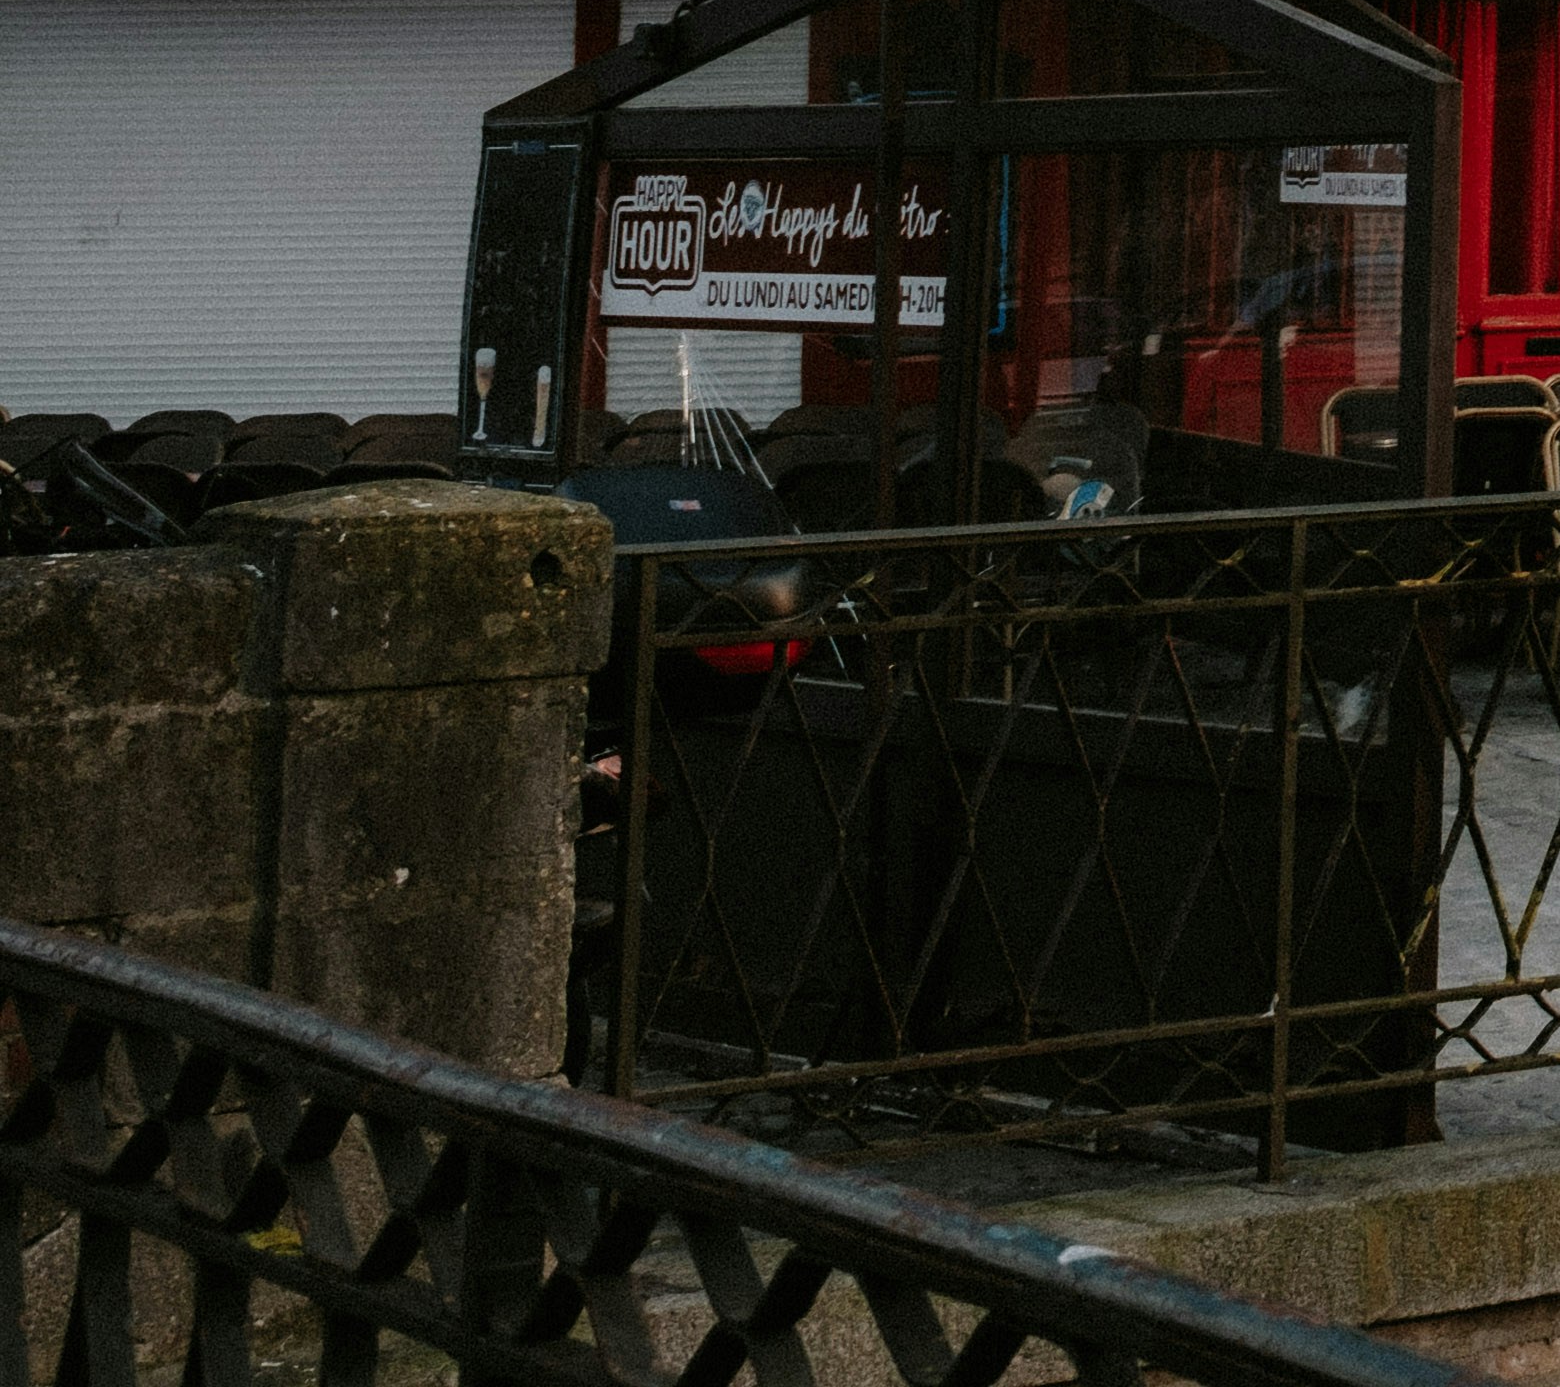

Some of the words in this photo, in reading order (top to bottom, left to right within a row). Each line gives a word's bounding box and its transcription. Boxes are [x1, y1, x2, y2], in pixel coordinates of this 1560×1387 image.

[636, 177, 687, 208] HAPPY
[753, 181, 840, 268] Happys
[842, 182, 870, 240] du
[619, 220, 692, 271] HOUR
[707, 280, 731, 307] DU
[735, 280, 784, 309] LUNDI
[786, 282, 810, 310] AU
[814, 282, 875, 311] SAMEDI
